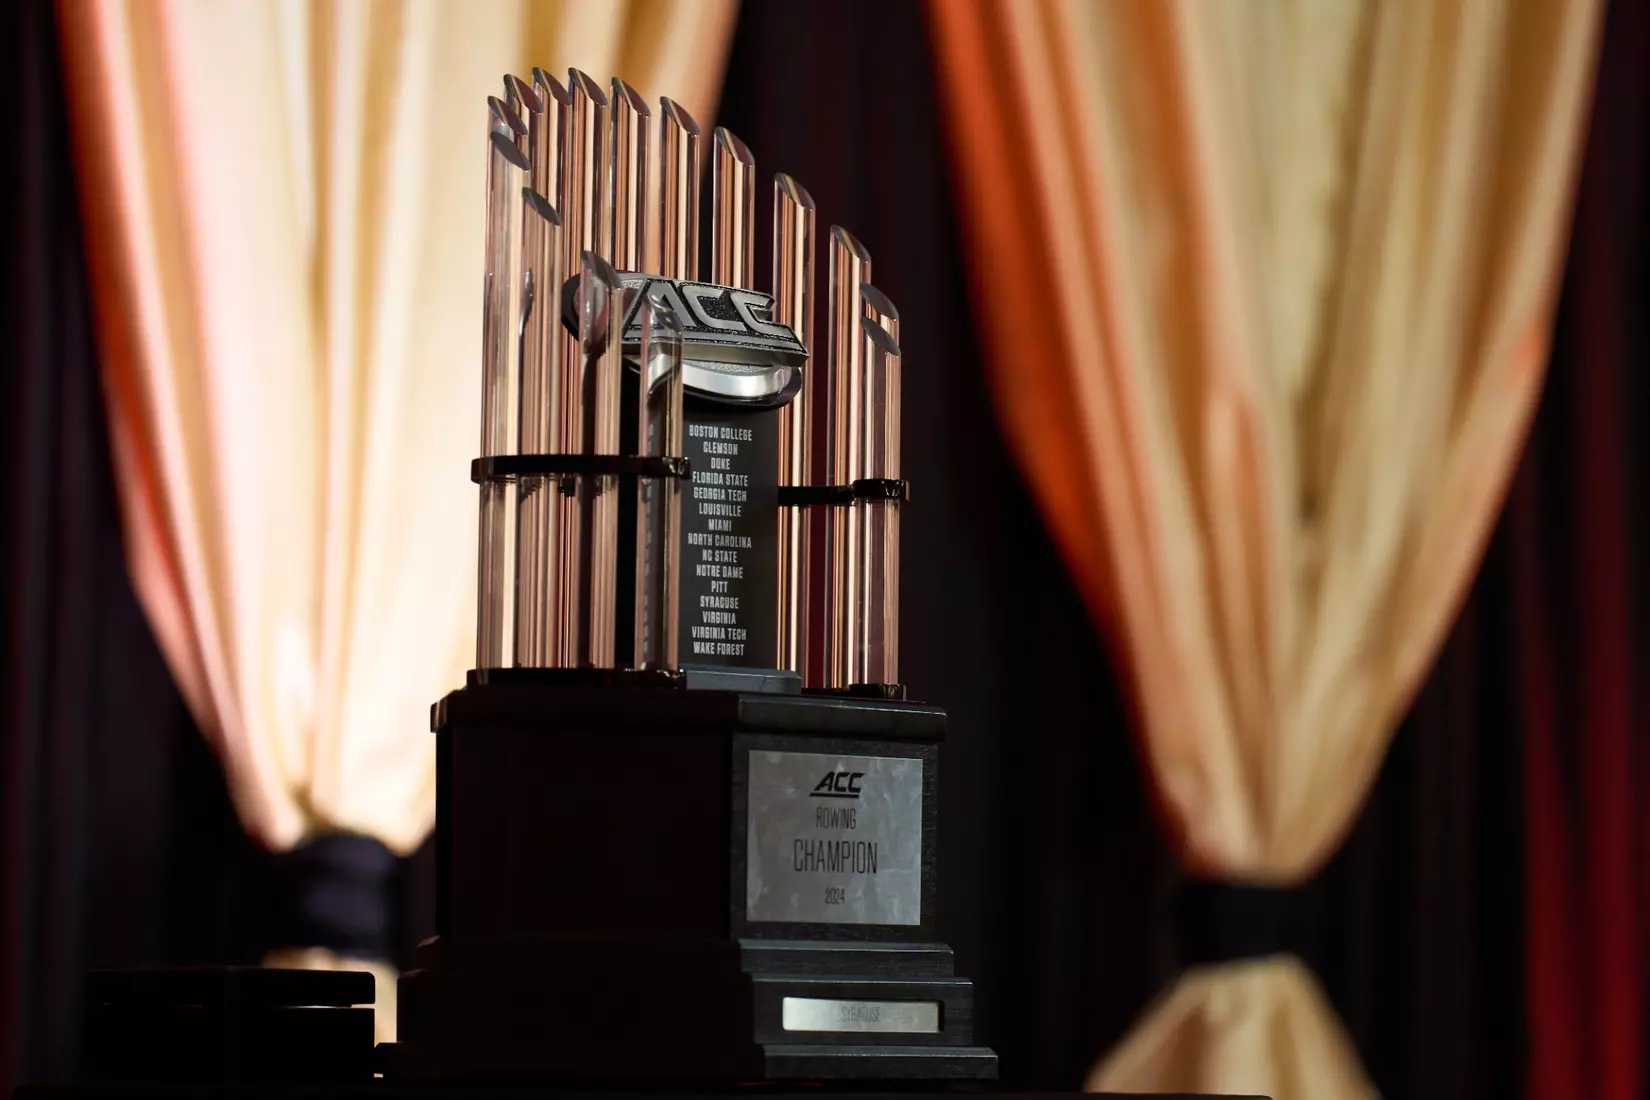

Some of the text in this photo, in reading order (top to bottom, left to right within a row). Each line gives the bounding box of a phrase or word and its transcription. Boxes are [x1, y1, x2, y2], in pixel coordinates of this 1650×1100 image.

[689, 424, 752, 441] BOSTON COLLEGE
[703, 441, 738, 455] CLEMSON
[710, 457, 730, 470] DUKE
[692, 471, 748, 486] FLORIDA STATE
[694, 486, 747, 502] GEORGIA TECH
[699, 502, 742, 517] LOUISVILLE
[708, 518, 732, 532] MIAMI
[688, 532, 752, 548] NORTH CAROLINA
[702, 549, 738, 562] NC STATE
[696, 564, 744, 578] NOTRE DAME
[711, 580, 728, 593] PITT
[700, 595, 740, 609] SYRACUSE
[702, 611, 736, 624] VIRGINIA
[692, 626, 747, 640] VIRGINIA TECH
[693, 641, 744, 656] WAKE FOREST
[814, 771, 866, 792] ACC
[816, 806, 857, 830] ROWING
[793, 838, 878, 874] CHAMPION
[824, 887, 845, 905] 2024
